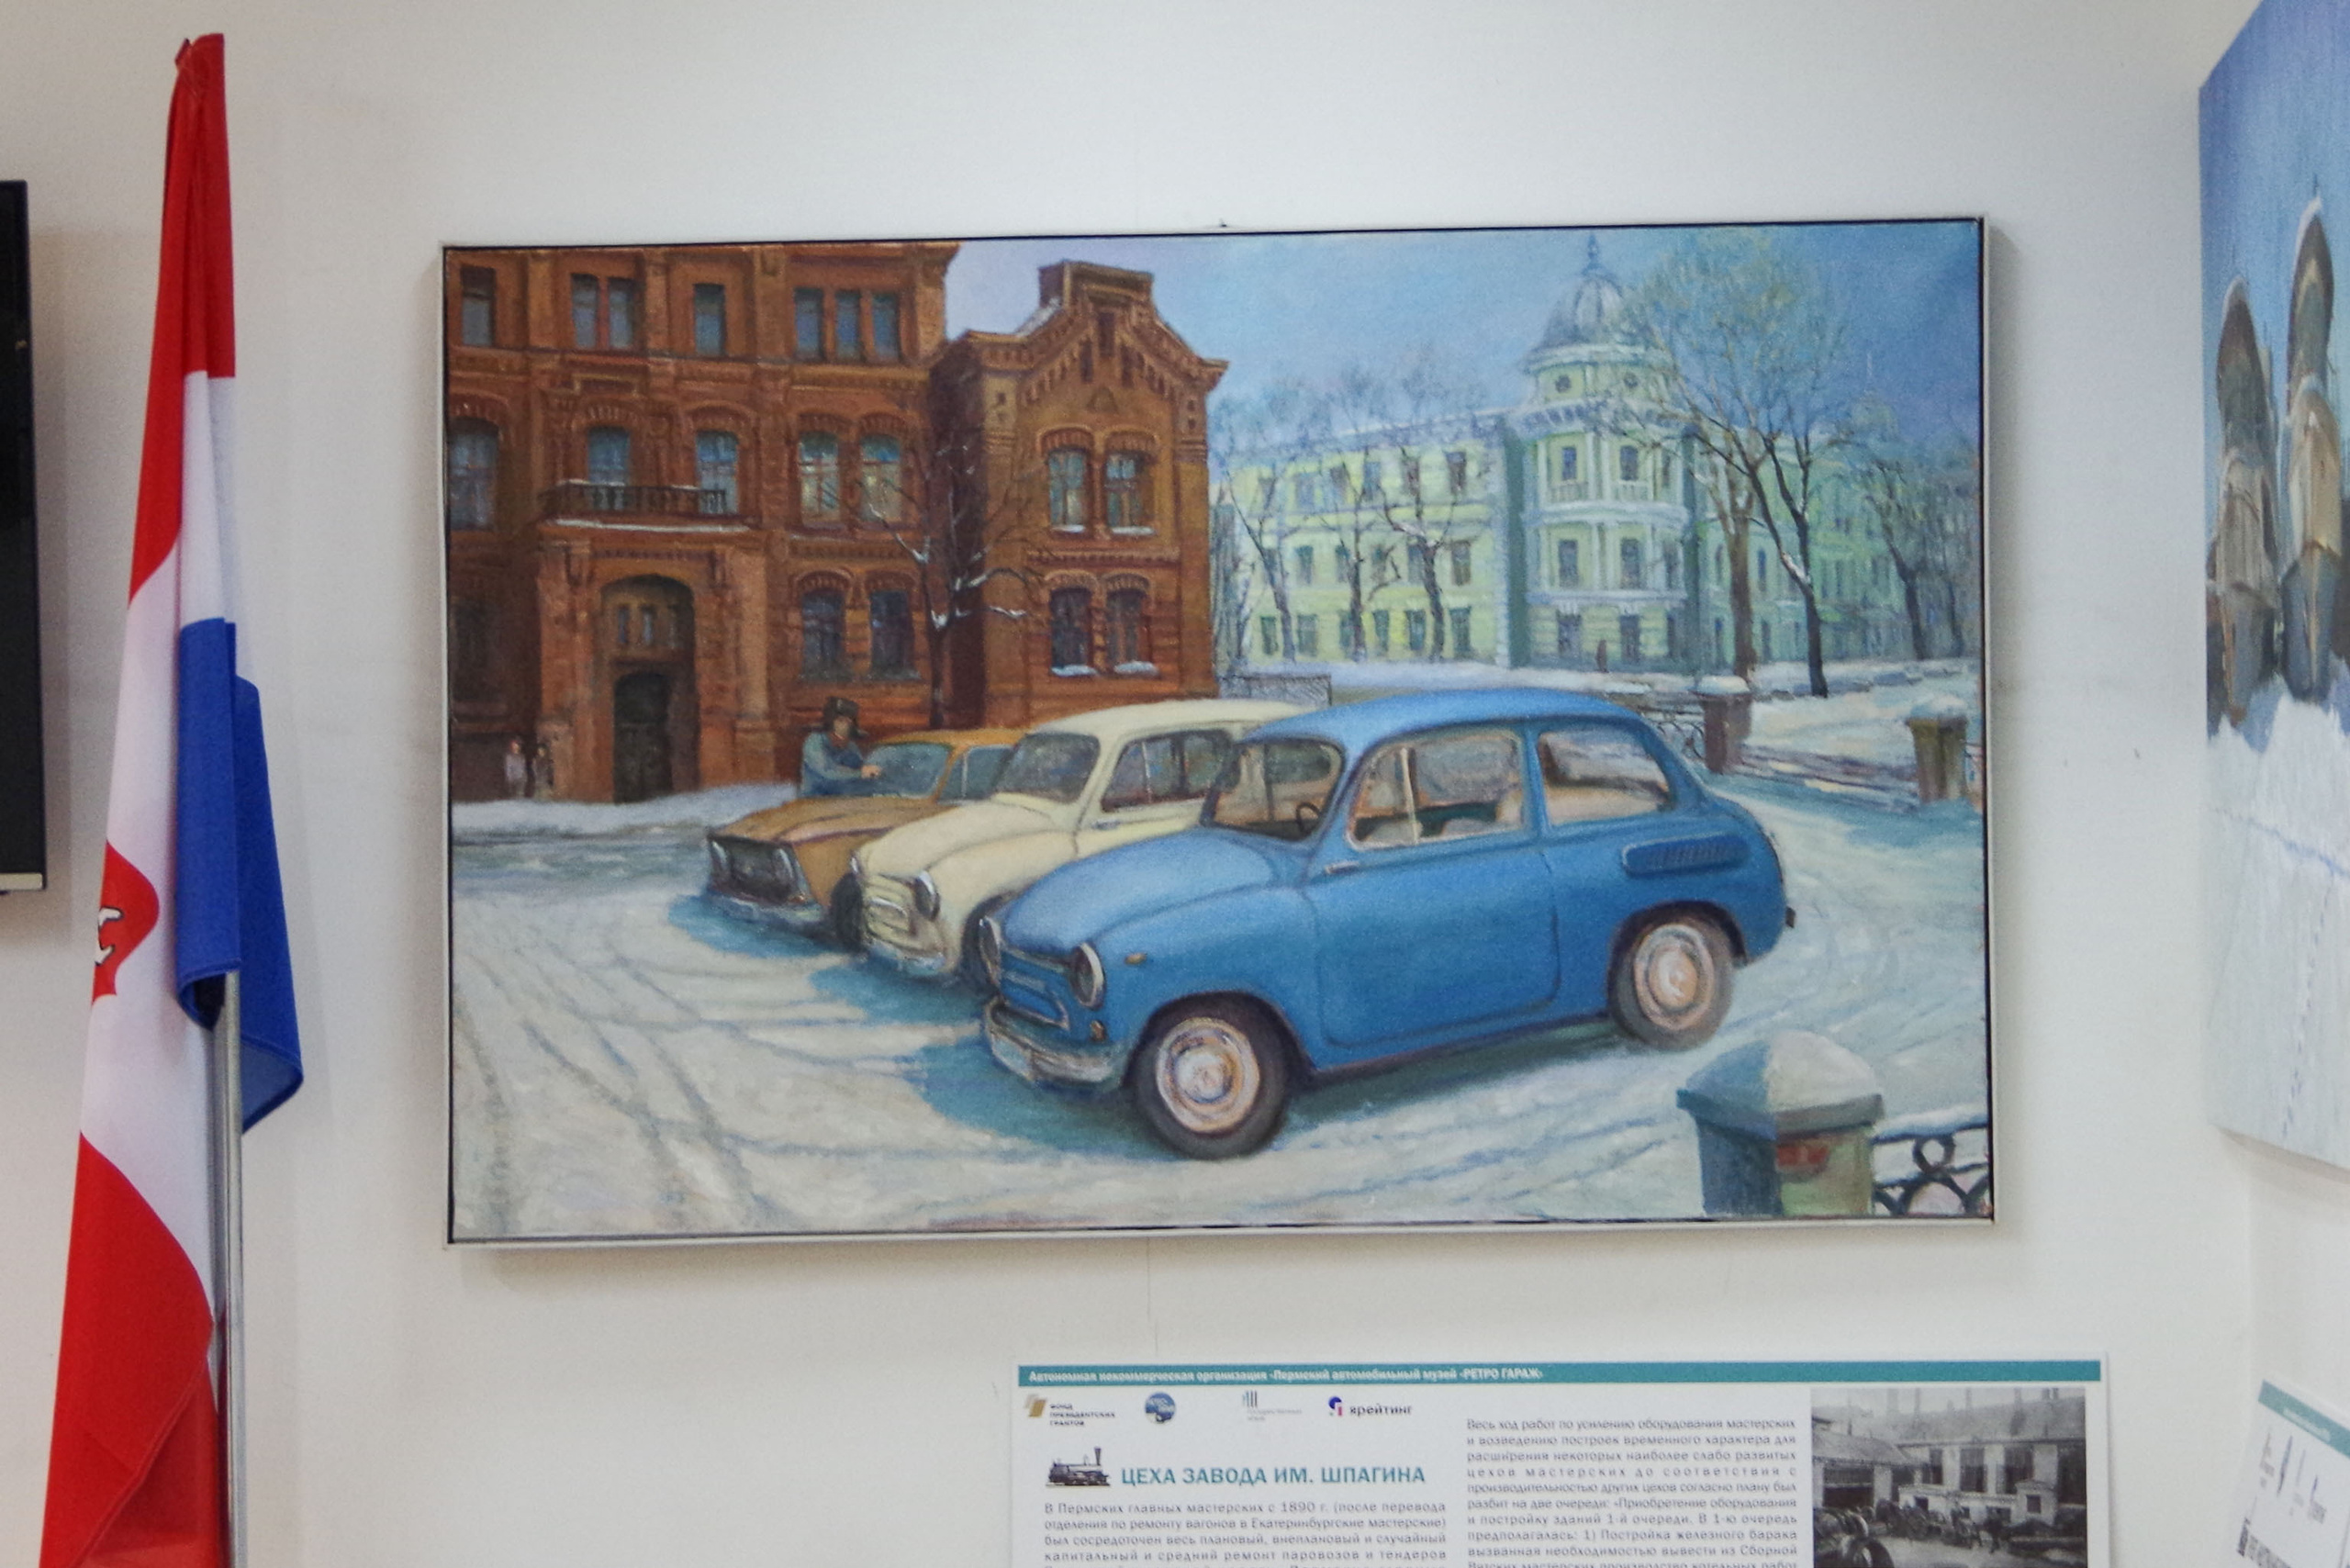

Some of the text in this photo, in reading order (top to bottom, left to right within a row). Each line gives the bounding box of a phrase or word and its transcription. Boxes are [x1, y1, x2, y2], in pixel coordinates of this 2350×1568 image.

[1029, 1371, 1098, 1383] Автономная
[1196, 1371, 1268, 1383] организация
[1332, 1369, 1421, 1381] автомобильный
[1423, 1368, 1457, 1382] музей
[1467, 1419, 1495, 1428] Весь
[1498, 1421, 1519, 1431] ход
[1521, 1419, 1555, 1430] работ
[1576, 1421, 1635, 1430] усилению
[1638, 1418, 1723, 1430] оборудования
[1726, 1421, 1796, 1430] мастерских
[1478, 1436, 1558, 1447] возведению
[1561, 1436, 1619, 1446] построек
[1623, 1436, 1701, 1446] временного
[1705, 1436, 1771, 1446] характера
[1774, 1436, 1796, 1446] для
[1467, 1450, 1796, 1462] расширения некоторых наиболее слабо развитых
[1121, 1467, 1426, 1486] ЦЕХА ЗАВОДА ИМ. ШПАГИНА
[1467, 1468, 1516, 1479] цехов
[1525, 1468, 1626, 1478] мастерских
[1635, 1468, 1653, 1478] до
[1467, 1482, 1797, 1495] производительностью других цехов согласно плану был
[1058, 1503, 1124, 1515] Пермских
[1127, 1505, 1181, 1513] главных
[1186, 1505, 1263, 1515] мастерских
[1281, 1502, 1315, 1512] 1890
[1333, 1502, 1378, 1514] (после
[1382, 1504, 1446, 1514] перевода
[1467, 1498, 1507, 1510] разбит
[1529, 1500, 1552, 1509] две
[1709, 1497, 1797, 1509] оборудования
[1044, 1520, 1108, 1531] отделения
[1110, 1520, 1126, 1529] по
[1129, 1520, 1181, 1530] ремонту
[1185, 1520, 1236, 1529] вагонов
[1251, 1518, 1364, 1530] Екатеринбургские
[1369, 1517, 1446, 1529] мастерские)
[1480, 1514, 1548, 1526] постройку
[1553, 1514, 1602, 1526] зданий
[1632, 1516, 1693, 1526] очереди.
[1712, 1514, 1737, 1524] 1-ю
[1740, 1516, 1797, 1526] очередь
[1044, 1534, 1069, 1544] был
[1072, 1536, 1162, 1547] сосредоточен
[1166, 1536, 1196, 1544] весь
[1200, 1534, 1269, 1546] плановый,
[1272, 1534, 1360, 1544] внеплановый
[1376, 1533, 1446, 1546] случайный
[1583, 1529, 1596, 1542] 1)
[1601, 1529, 1671, 1541] Постройка
[1676, 1531, 1744, 1540] железного
[1749, 1529, 1797, 1541] барака
[1044, 1551, 1138, 1561] капитальный
[1158, 1550, 1218, 1562] средний
[1224, 1551, 1276, 1562] ремонт
[1281, 1551, 1360, 1562] паровозов
[1379, 1551, 1447, 1562] тендеров
[1468, 1544, 1797, 1557] вызванная необходимостью вывести из Сборной
